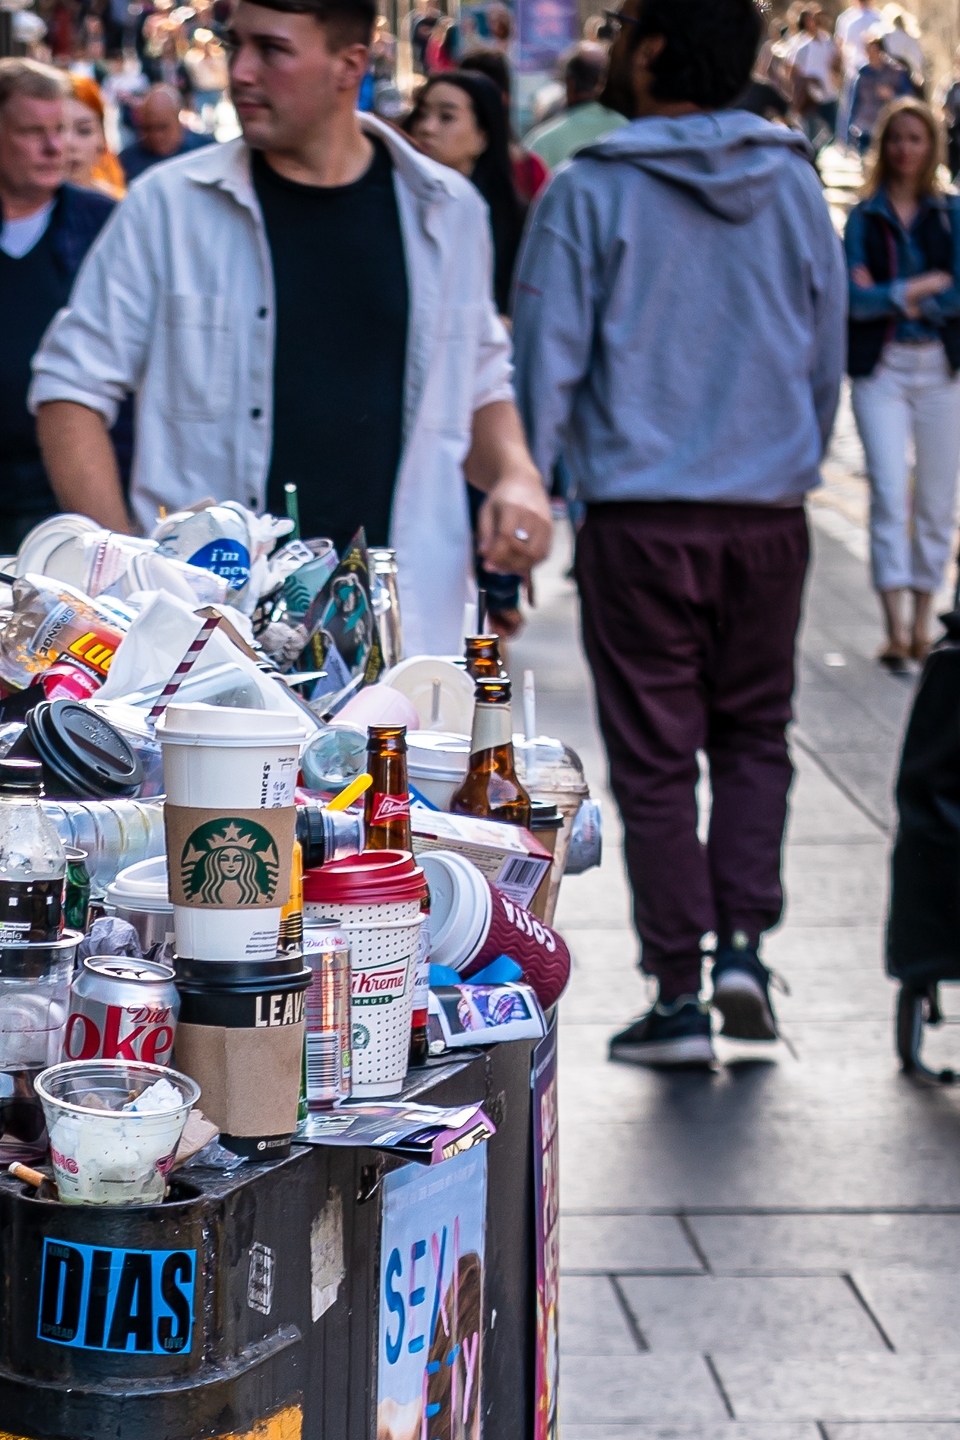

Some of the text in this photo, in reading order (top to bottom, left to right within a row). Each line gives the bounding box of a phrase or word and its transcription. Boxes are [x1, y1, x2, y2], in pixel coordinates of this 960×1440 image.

[210, 548, 238, 561] i'm
[39, 608, 76, 658] ORANGE
[259, 762, 271, 808] BUCKS
[501, 897, 557, 953] COSTA
[357, 966, 405, 993] Kreme
[127, 1003, 172, 1024] Diet
[48, 1244, 70, 1259] KING
[41, 1240, 193, 1353] DIAS
[163, 1336, 184, 1350] LOVE
